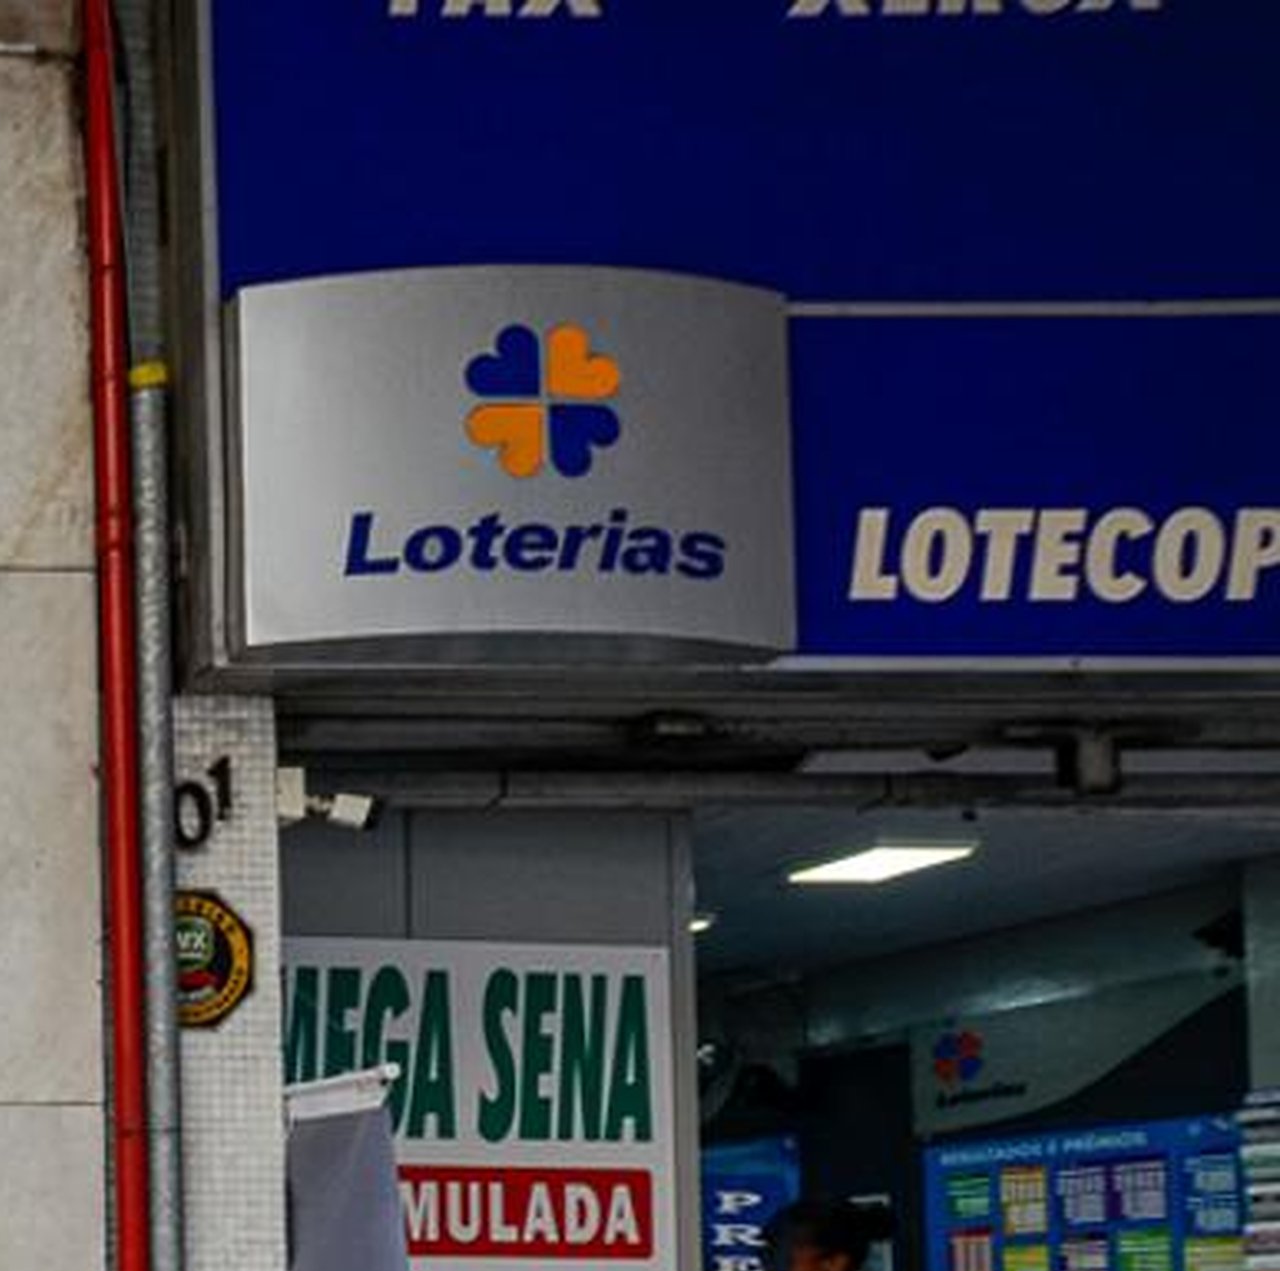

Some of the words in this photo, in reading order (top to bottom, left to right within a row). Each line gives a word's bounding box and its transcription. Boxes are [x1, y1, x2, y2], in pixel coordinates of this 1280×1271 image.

[343, 508, 727, 580] Loterias
[849, 507, 1280, 602] LOTECOP
[477, 967, 653, 1143] SENA
